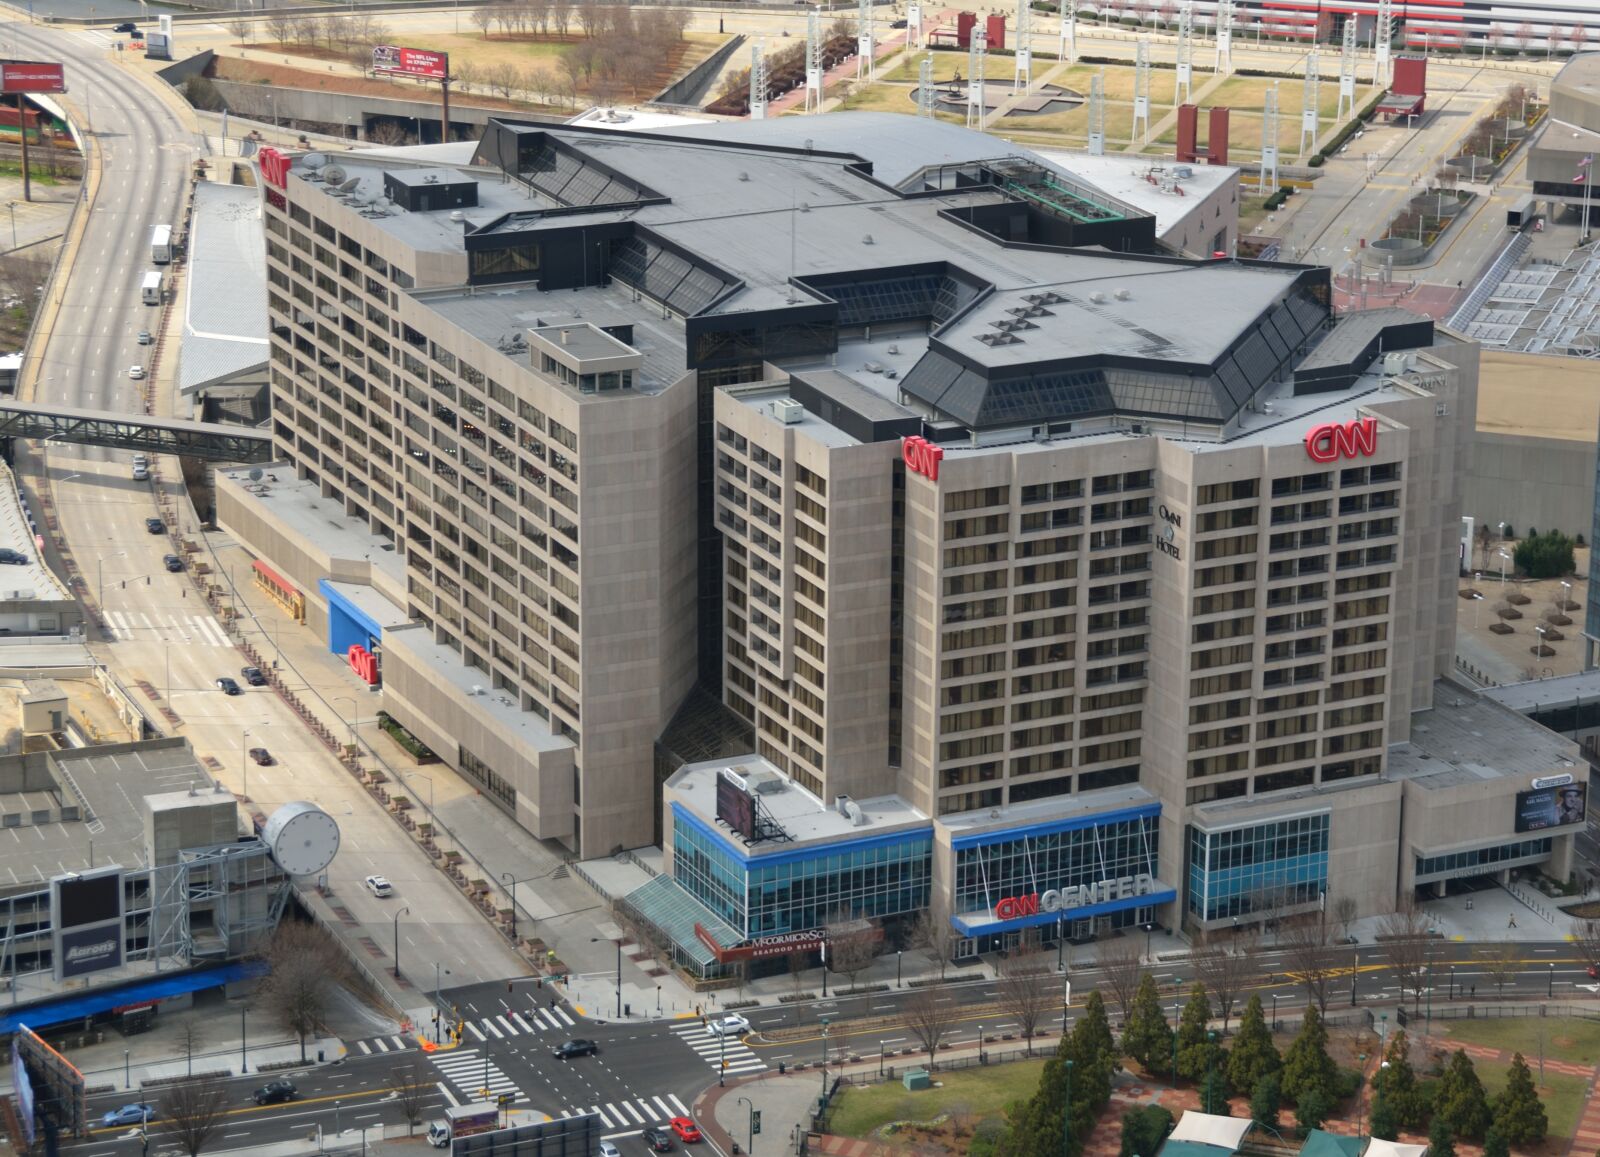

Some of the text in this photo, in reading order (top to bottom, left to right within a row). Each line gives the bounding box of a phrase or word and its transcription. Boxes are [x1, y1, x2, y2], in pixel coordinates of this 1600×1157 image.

[258, 146, 290, 189] CNN
[902, 435, 943, 481] CNN
[1306, 417, 1377, 463] CNN
[1159, 505, 1181, 528] OMNI
[1156, 535, 1181, 560] HOTEL
[348, 644, 378, 685] CNN
[995, 873, 1153, 921] CNN CENTER
[753, 946, 793, 956] SEAFOOD
